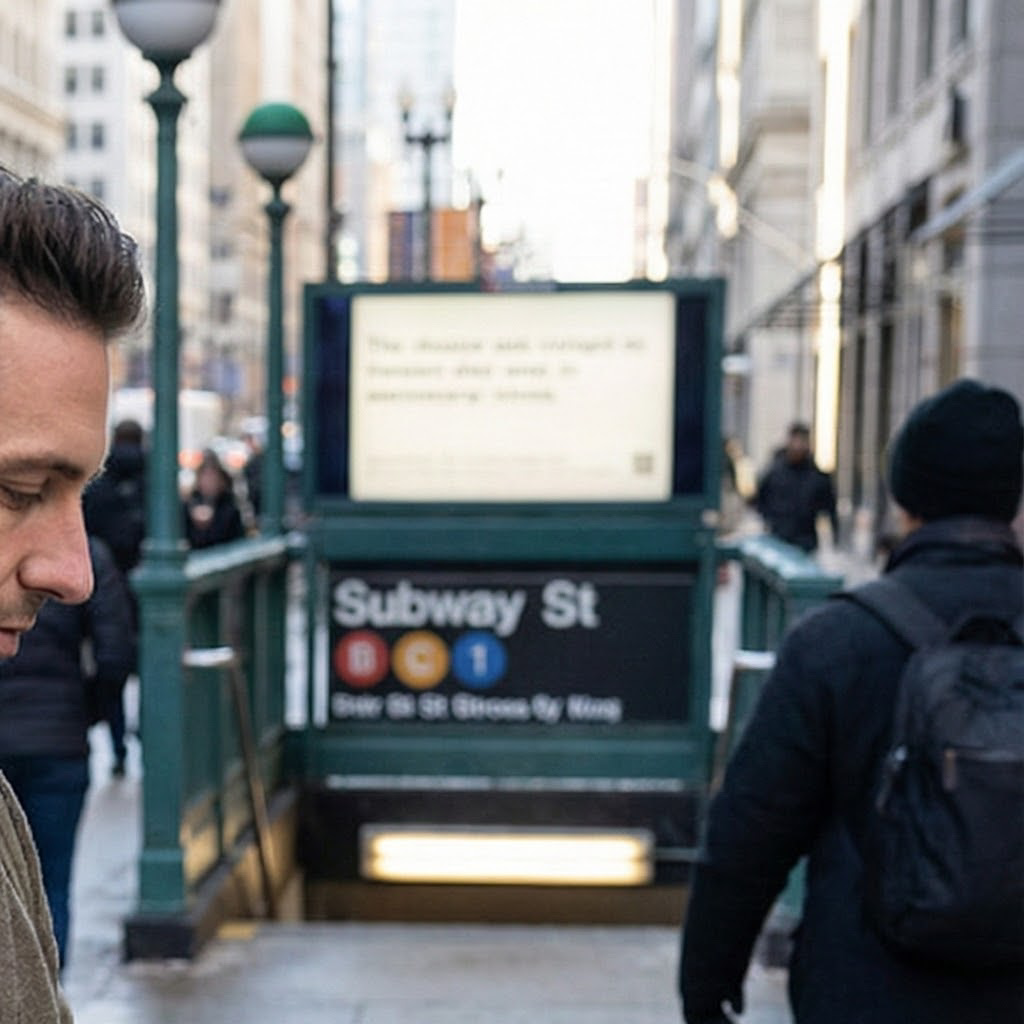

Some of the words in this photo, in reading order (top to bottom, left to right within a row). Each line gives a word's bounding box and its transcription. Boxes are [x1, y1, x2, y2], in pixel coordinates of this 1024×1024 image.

[333, 578, 527, 637] Subway
[541, 578, 601, 629] St
[404, 640, 437, 678] C
[469, 642, 488, 677] 1
